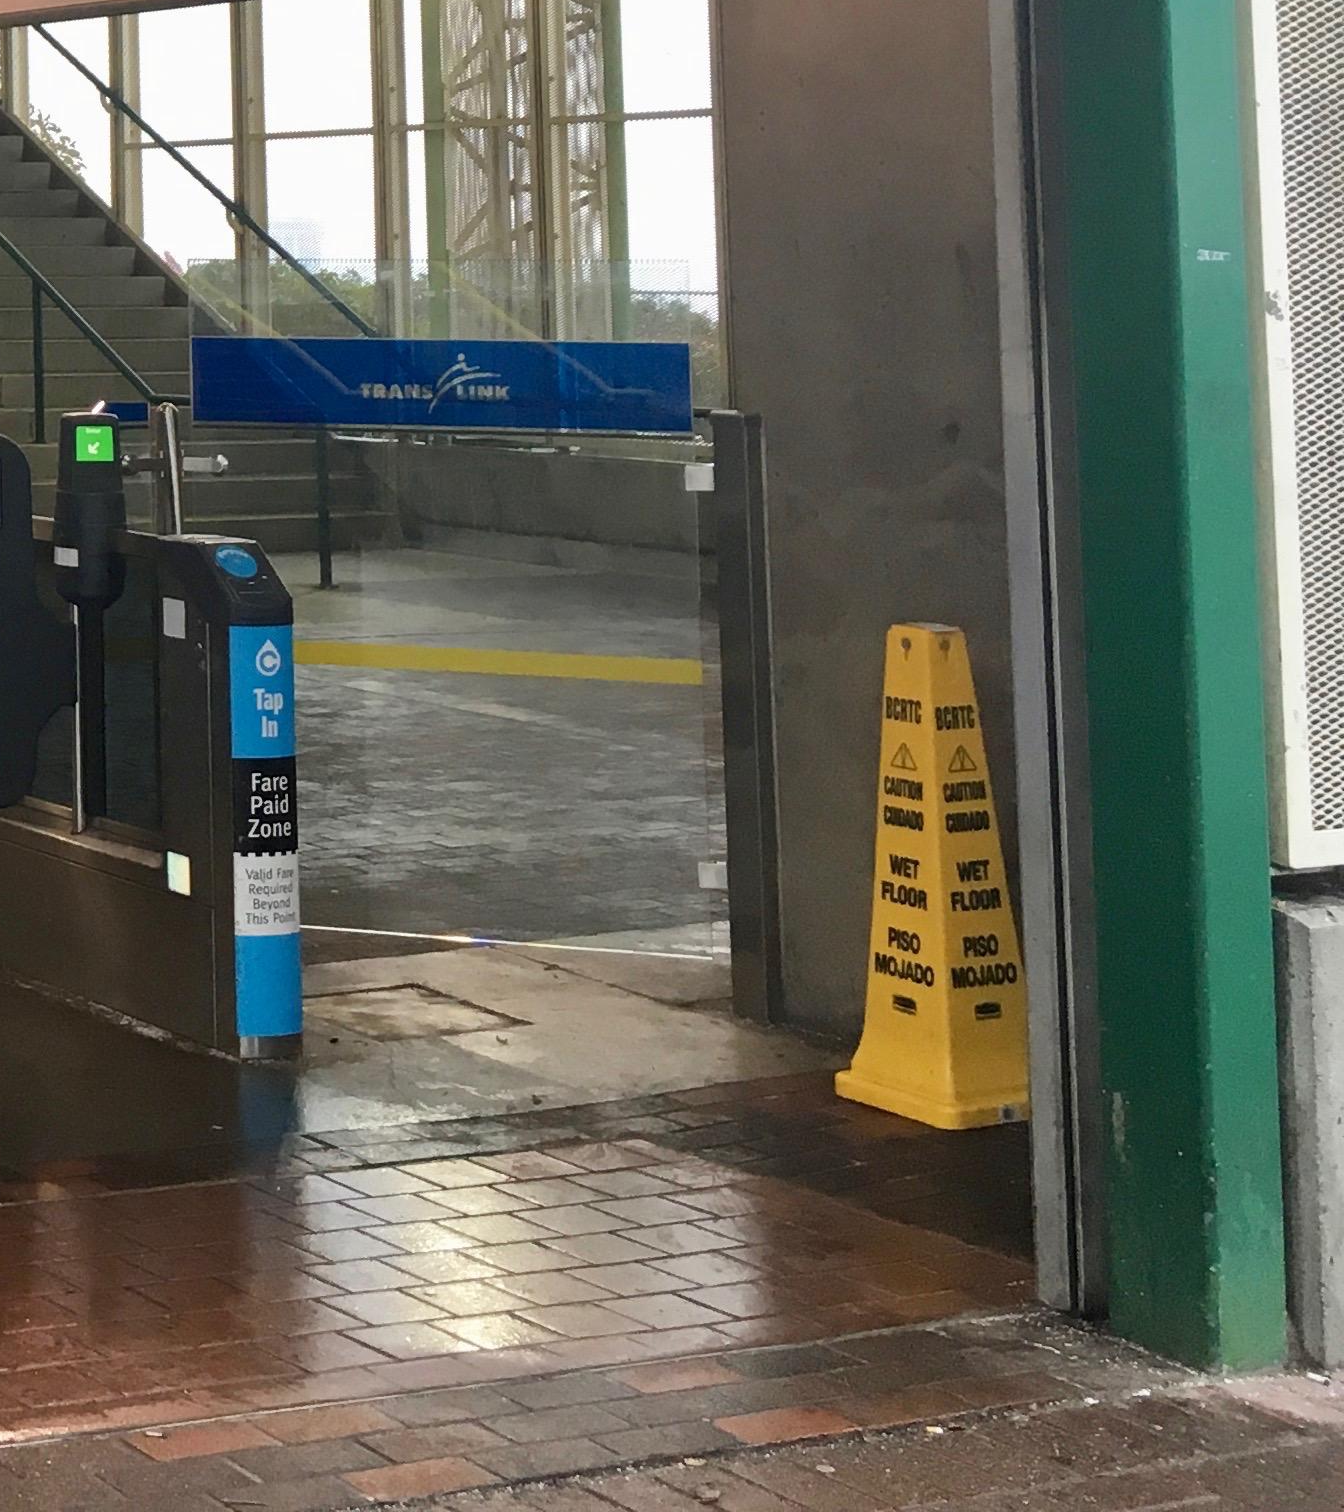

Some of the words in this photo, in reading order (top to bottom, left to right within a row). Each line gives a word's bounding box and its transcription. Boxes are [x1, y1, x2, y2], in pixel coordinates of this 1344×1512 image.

[359, 383, 434, 401] TRANS
[456, 384, 511, 401] LINK
[253, 688, 283, 714] Tap
[885, 696, 922, 725] BCRTC
[262, 716, 278, 737] In
[935, 704, 975, 731] BCRTC
[251, 773, 288, 792] Fare
[883, 775, 923, 801] CAUTION
[943, 780, 986, 802] CAUTION
[250, 796, 289, 815] Paid
[248, 818, 292, 838] Zone
[883, 804, 924, 832] CUIDADO
[945, 810, 990, 833] CUIDADO
[246, 868, 272, 882] Valid
[277, 867, 294, 879] Fare
[889, 854, 920, 880] WET
[956, 859, 990, 882] WET
[248, 883, 293, 898] Required
[881, 880, 927, 912] FLOOR
[950, 886, 1002, 912] FLOOR
[253, 898, 290, 912] Beyond
[246, 912, 269, 924] This
[273, 911, 296, 924] Point
[887, 927, 920, 955] PISO
[962, 934, 999, 958] PISO
[874, 952, 934, 987] MOJADO
[951, 962, 1018, 989] MOJADO
